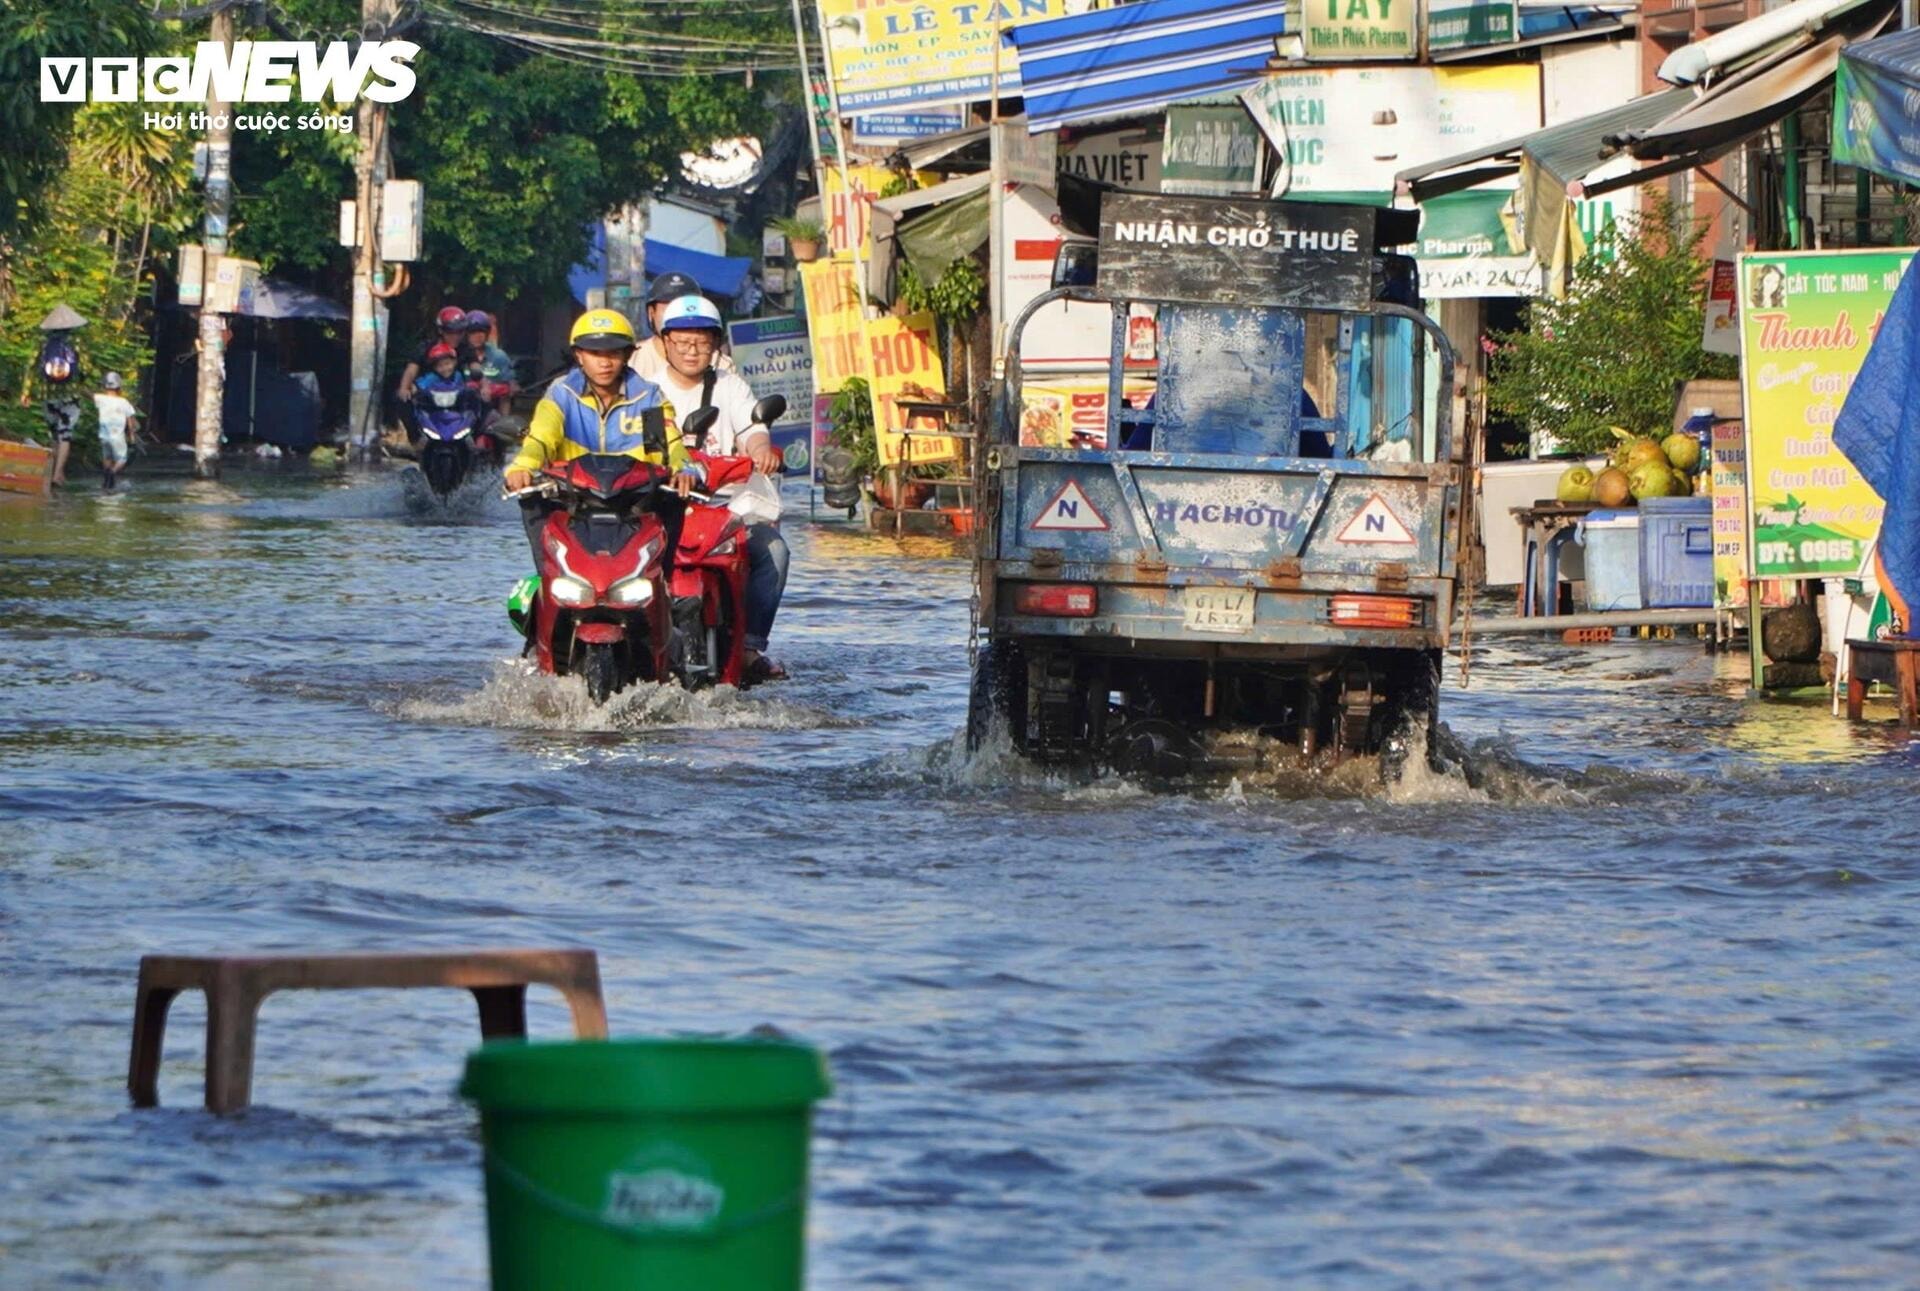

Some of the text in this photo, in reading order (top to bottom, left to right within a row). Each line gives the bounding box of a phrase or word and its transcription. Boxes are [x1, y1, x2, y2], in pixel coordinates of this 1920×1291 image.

[885, 6, 939, 36] LÊ
[1311, 27, 1339, 46] Thiên
[1369, 28, 1407, 47] Pharma
[1092, 150, 1148, 185] VIỆT
[1115, 219, 1359, 252] NHẬN CHỞ THUÊ
[1814, 272, 1837, 293] TÓC
[1841, 274, 1868, 291] NAM
[1752, 310, 1859, 351] Thanh
[1057, 500, 1078, 518] N
[1365, 515, 1385, 532] N
